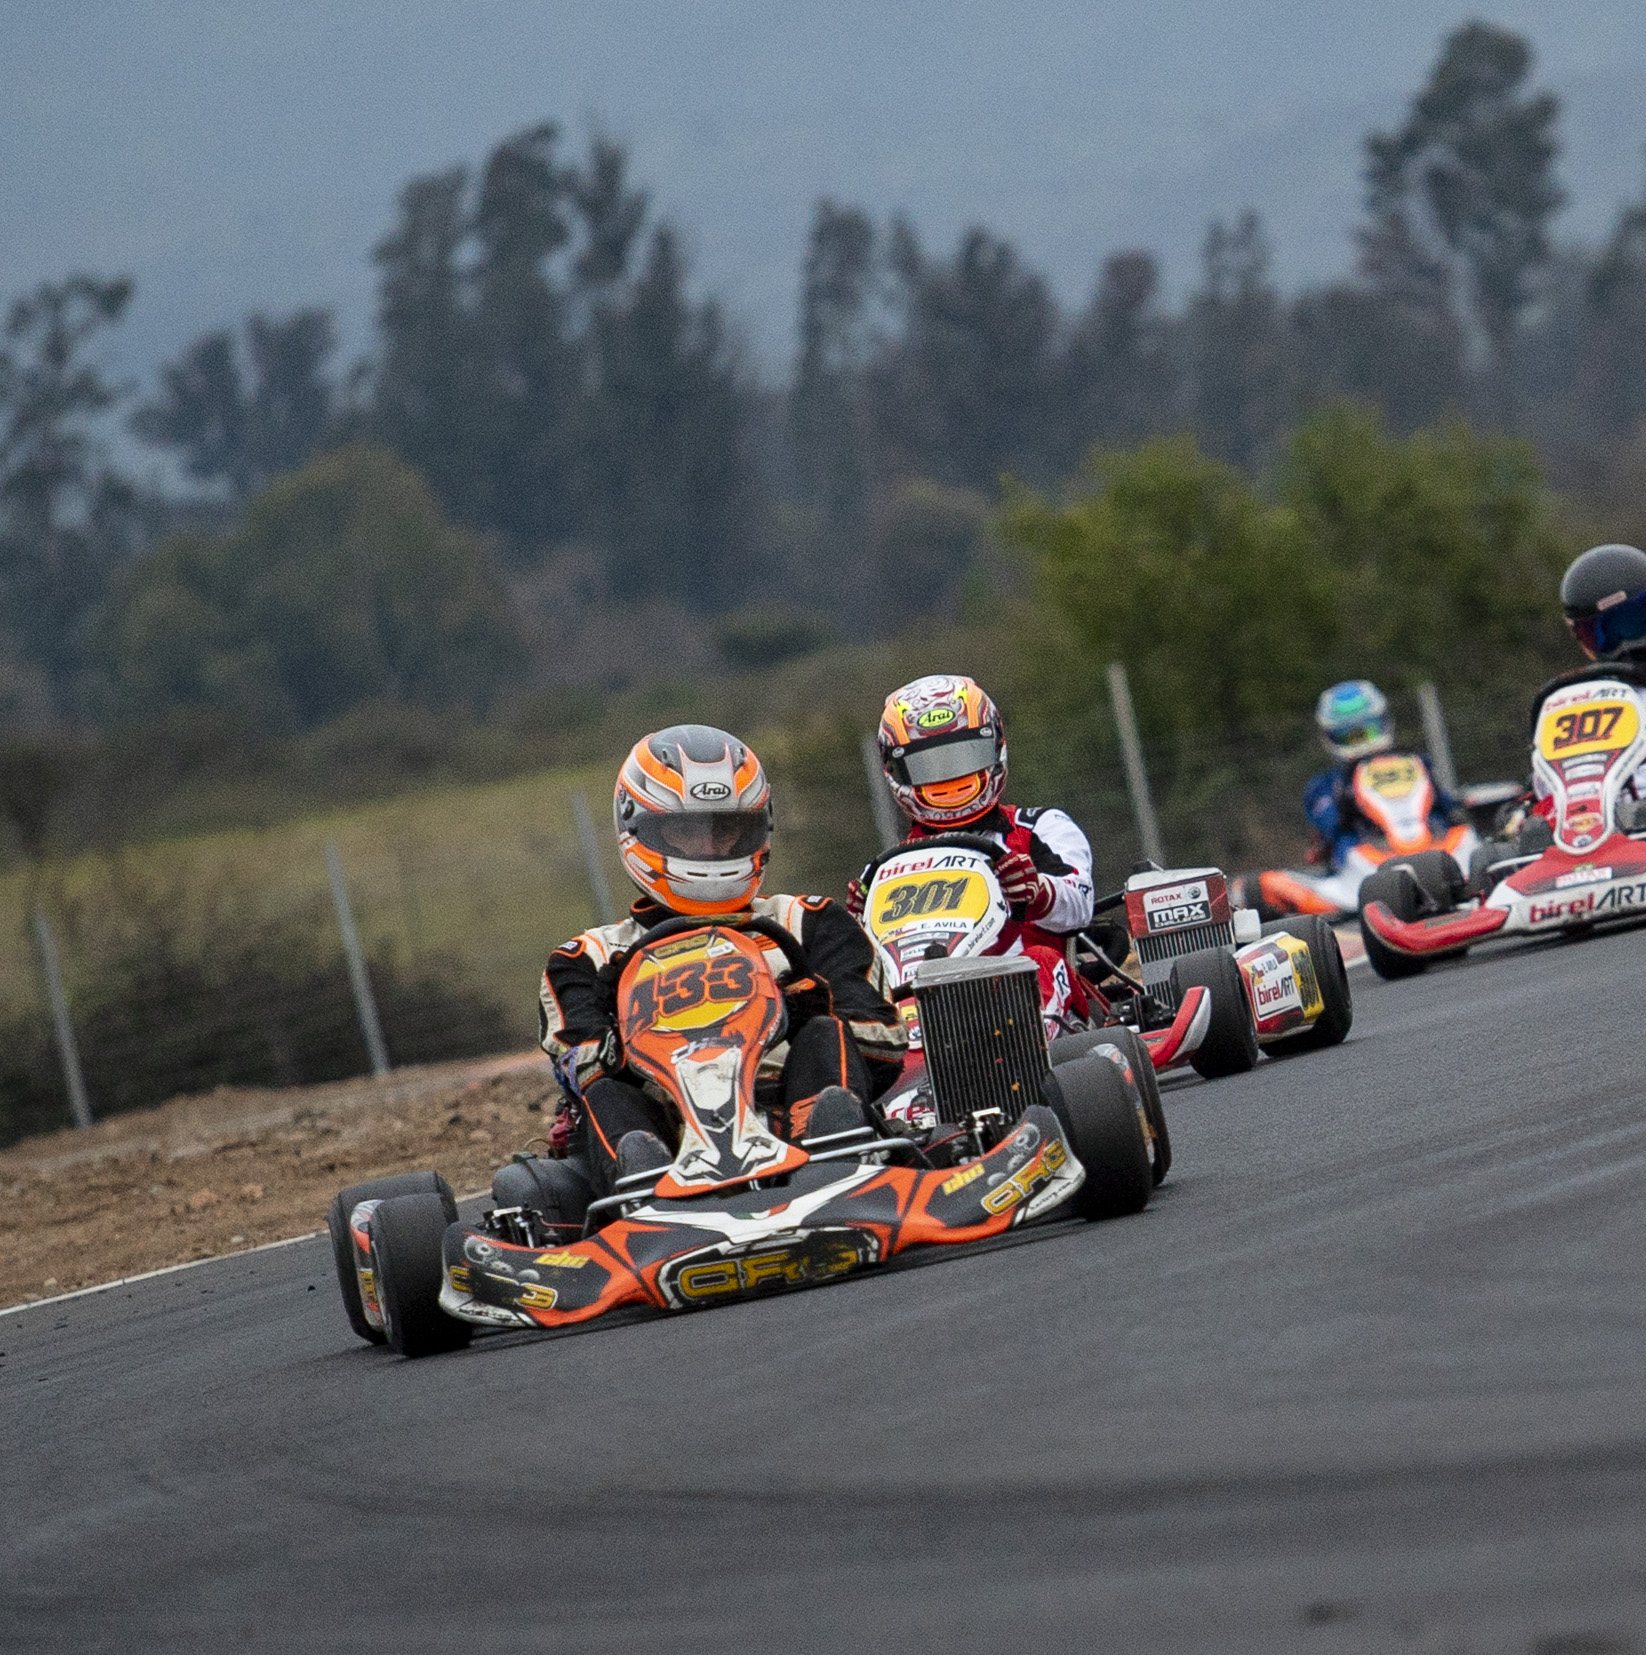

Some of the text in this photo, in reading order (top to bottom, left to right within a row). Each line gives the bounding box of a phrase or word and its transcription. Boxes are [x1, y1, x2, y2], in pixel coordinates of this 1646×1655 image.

[923, 710, 951, 725] Arai
[1553, 706, 1624, 751] 307
[696, 783, 726, 796] Arai
[878, 855, 980, 881] birelART
[879, 876, 971, 924] 301
[1151, 893, 1181, 904] ROTAX
[1153, 903, 1205, 923] MAX
[934, 921, 967, 929] AVILA
[625, 955, 757, 1044] 433
[1257, 976, 1295, 1006] birelART
